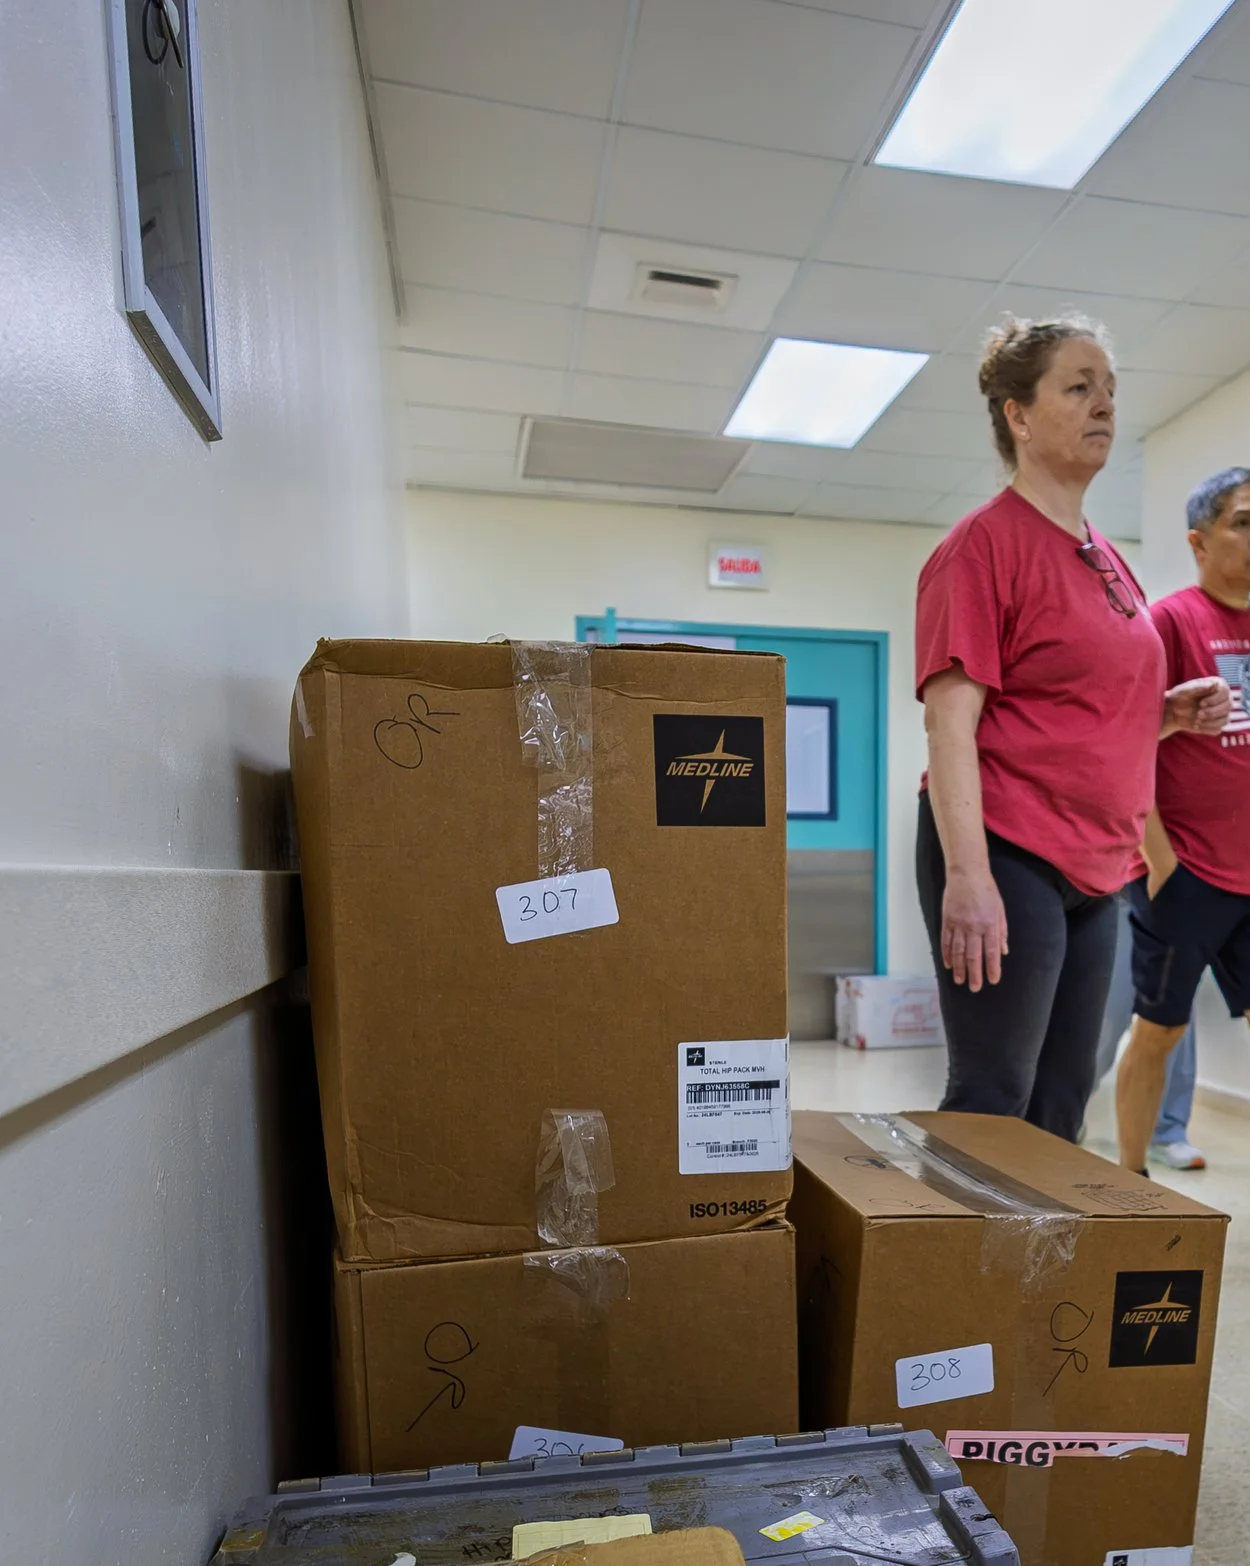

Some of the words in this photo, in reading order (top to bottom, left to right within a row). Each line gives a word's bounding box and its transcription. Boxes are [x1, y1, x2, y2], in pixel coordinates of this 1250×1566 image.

[718, 557, 761, 573] SALIDA
[374, 694, 461, 769] OR
[666, 762, 754, 777] MEDLINE
[519, 888, 577, 922] 307
[687, 1084, 704, 1092] REF:
[689, 1199, 767, 1218] ISO13485
[1121, 1309, 1192, 1325] MEDLINE
[1042, 1302, 1094, 1397] OR
[910, 1358, 961, 1391] 308
